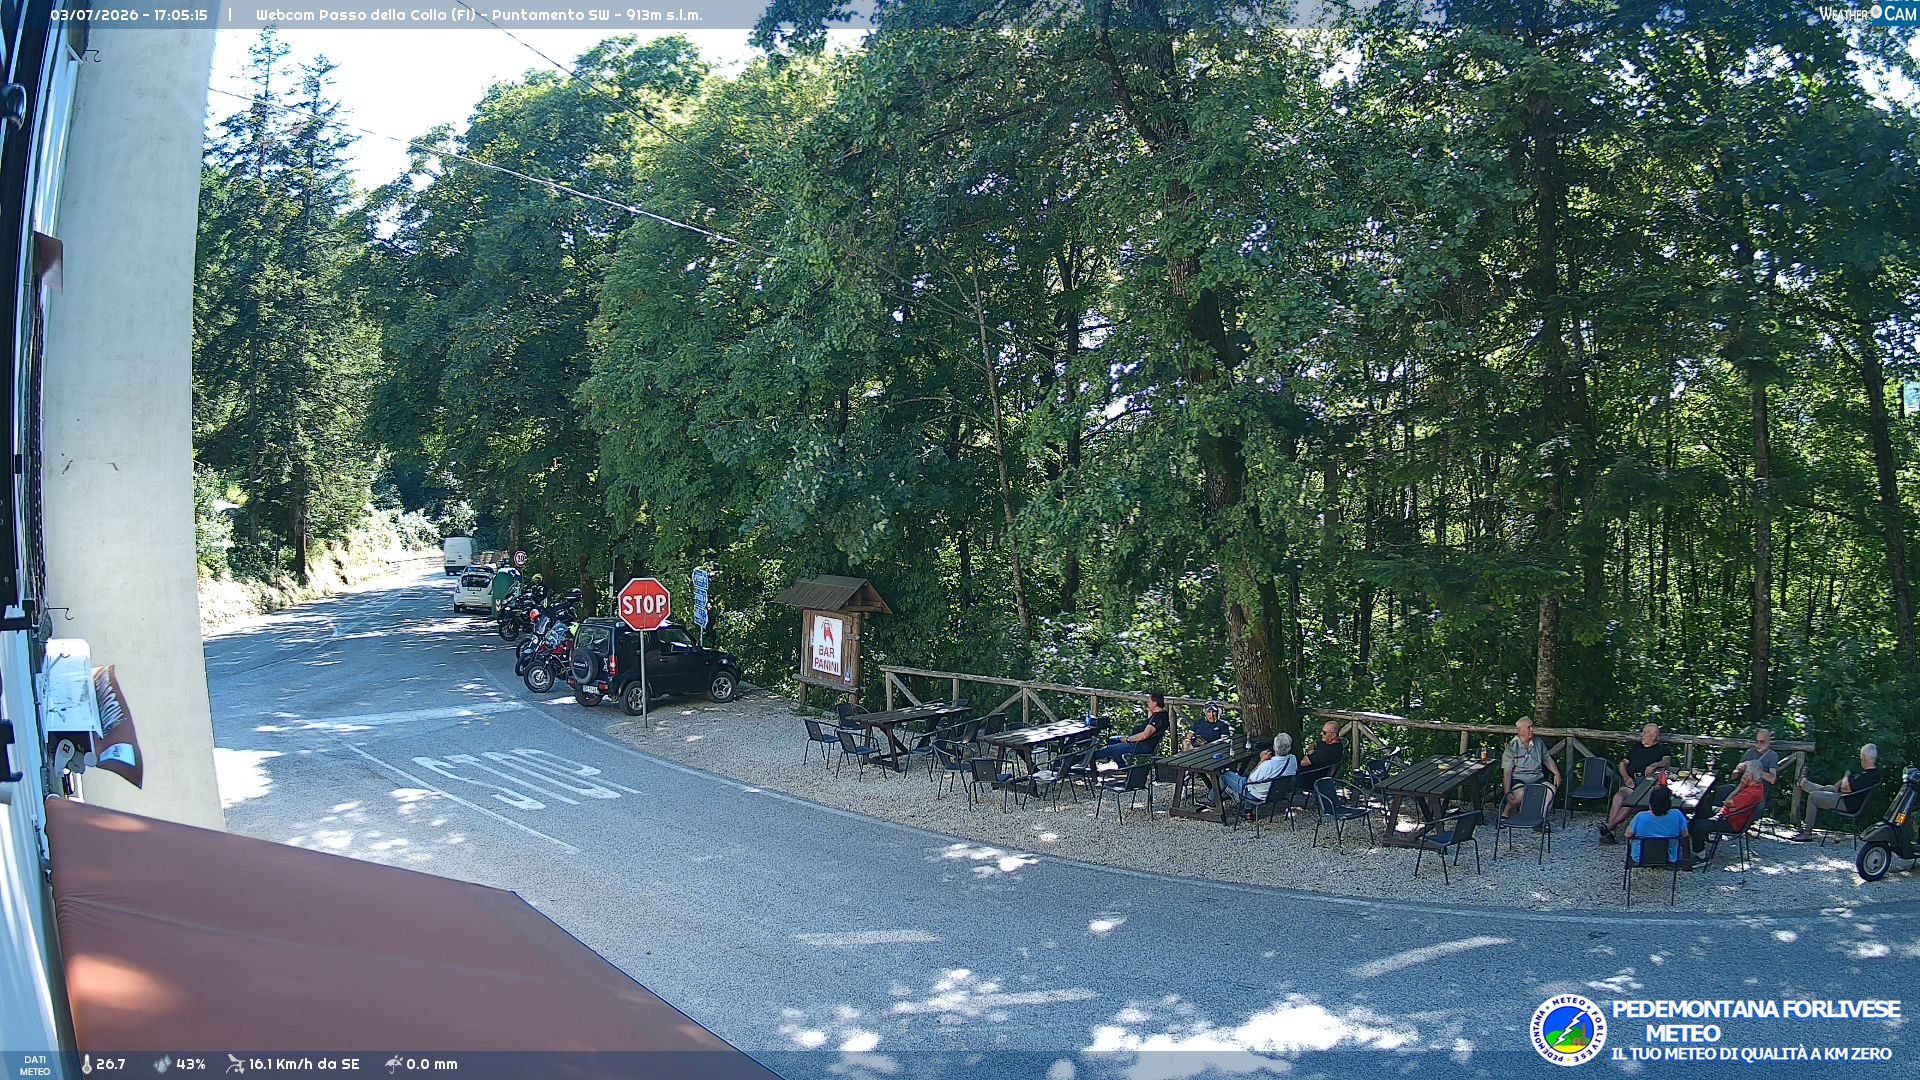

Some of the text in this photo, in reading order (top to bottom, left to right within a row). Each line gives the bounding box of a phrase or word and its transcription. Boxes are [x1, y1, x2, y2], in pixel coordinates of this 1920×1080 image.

[622, 594, 666, 615] STOP
[818, 644, 835, 659] BAR
[814, 657, 839, 673] PANINI
